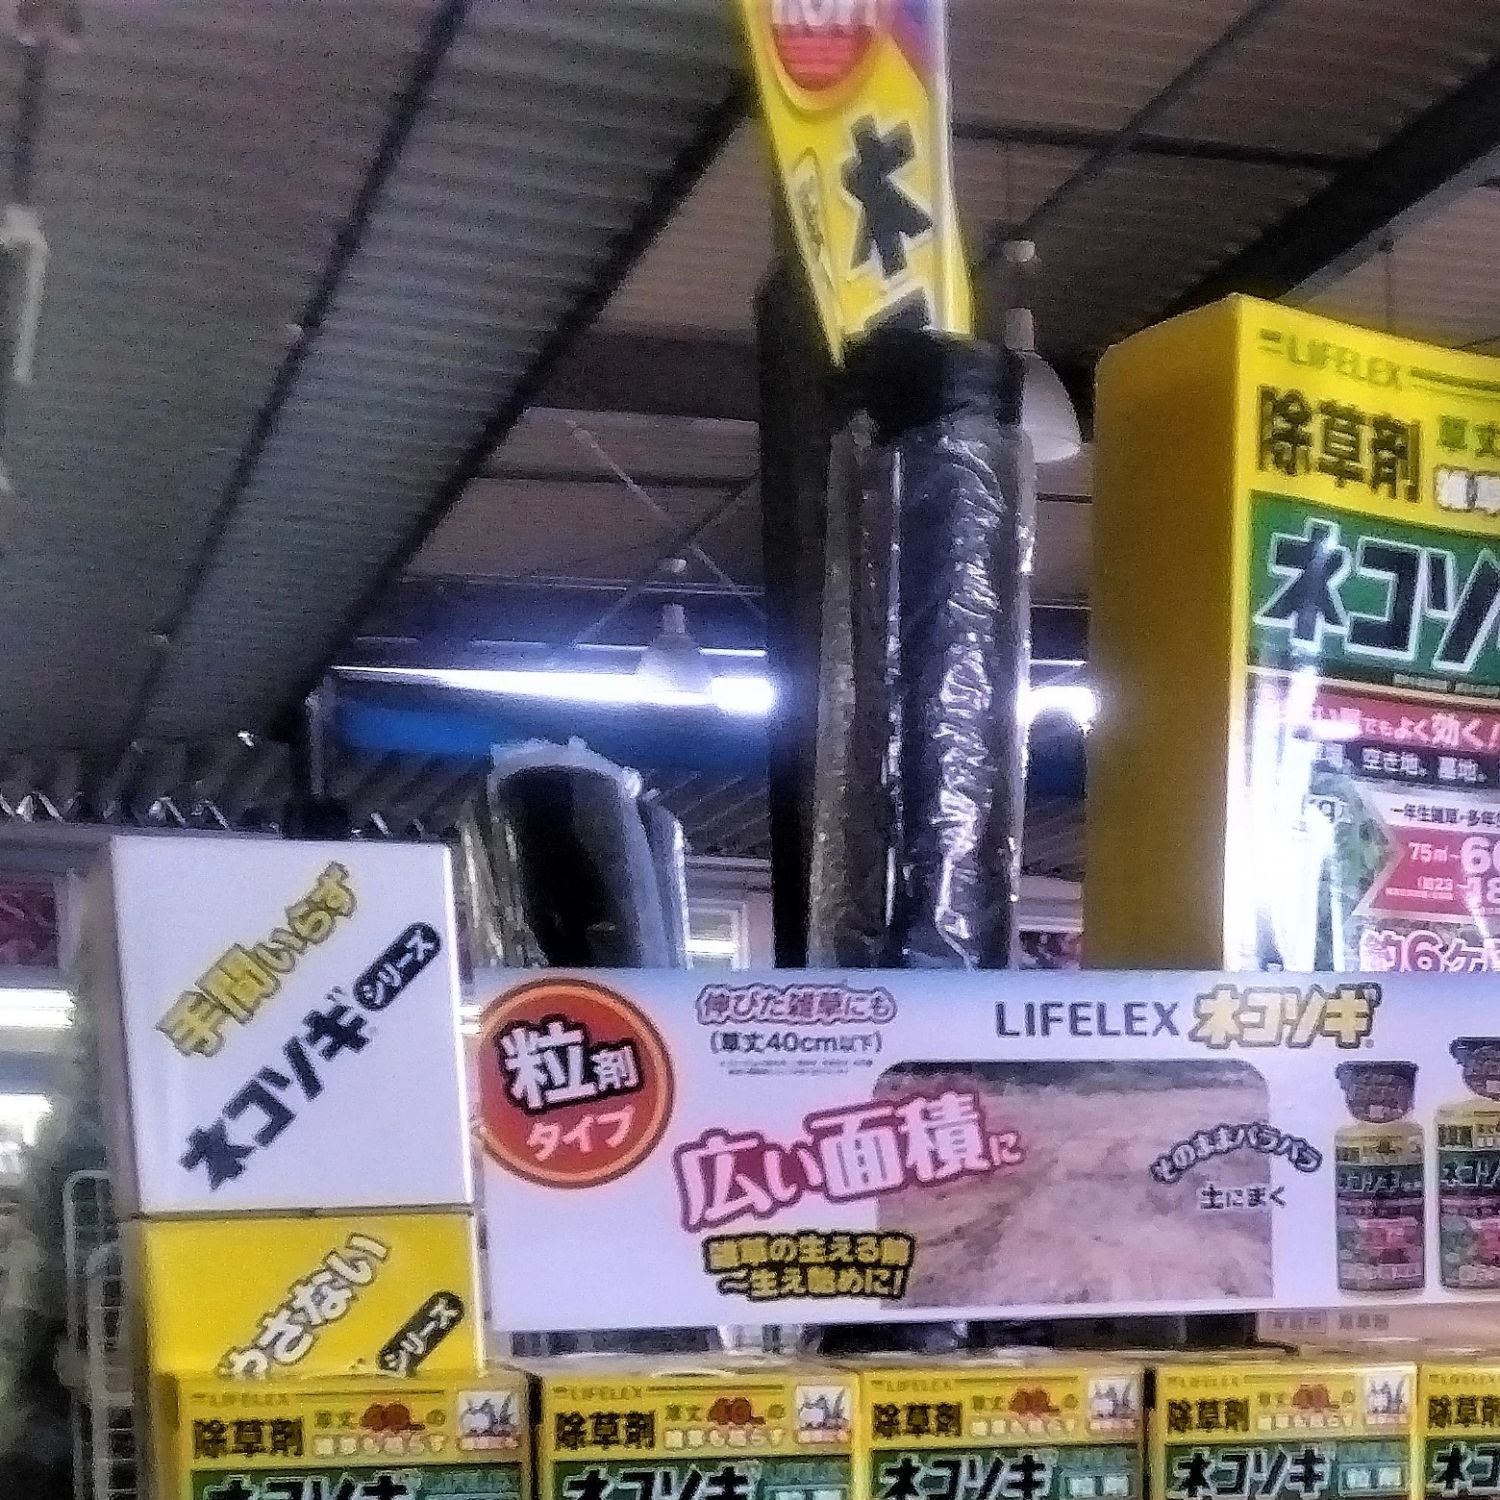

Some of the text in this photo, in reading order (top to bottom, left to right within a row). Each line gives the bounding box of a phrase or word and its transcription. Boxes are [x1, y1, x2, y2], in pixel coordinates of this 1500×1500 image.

[1257, 384, 1421, 504] 除草剤
[155, 862, 358, 1058] 手間いらず
[354, 922, 441, 1011] シリーズ
[995, 1001, 1180, 1038] LIFELEX
[1188, 984, 1382, 1049] ネコソギ
[178, 986, 378, 1192] ネコソギ
[499, 1015, 646, 1113] 粒剤
[526, 1106, 634, 1162] タイプ
[676, 1091, 1027, 1232] 広い面積に
[1200, 1183, 1287, 1211] 土にまく
